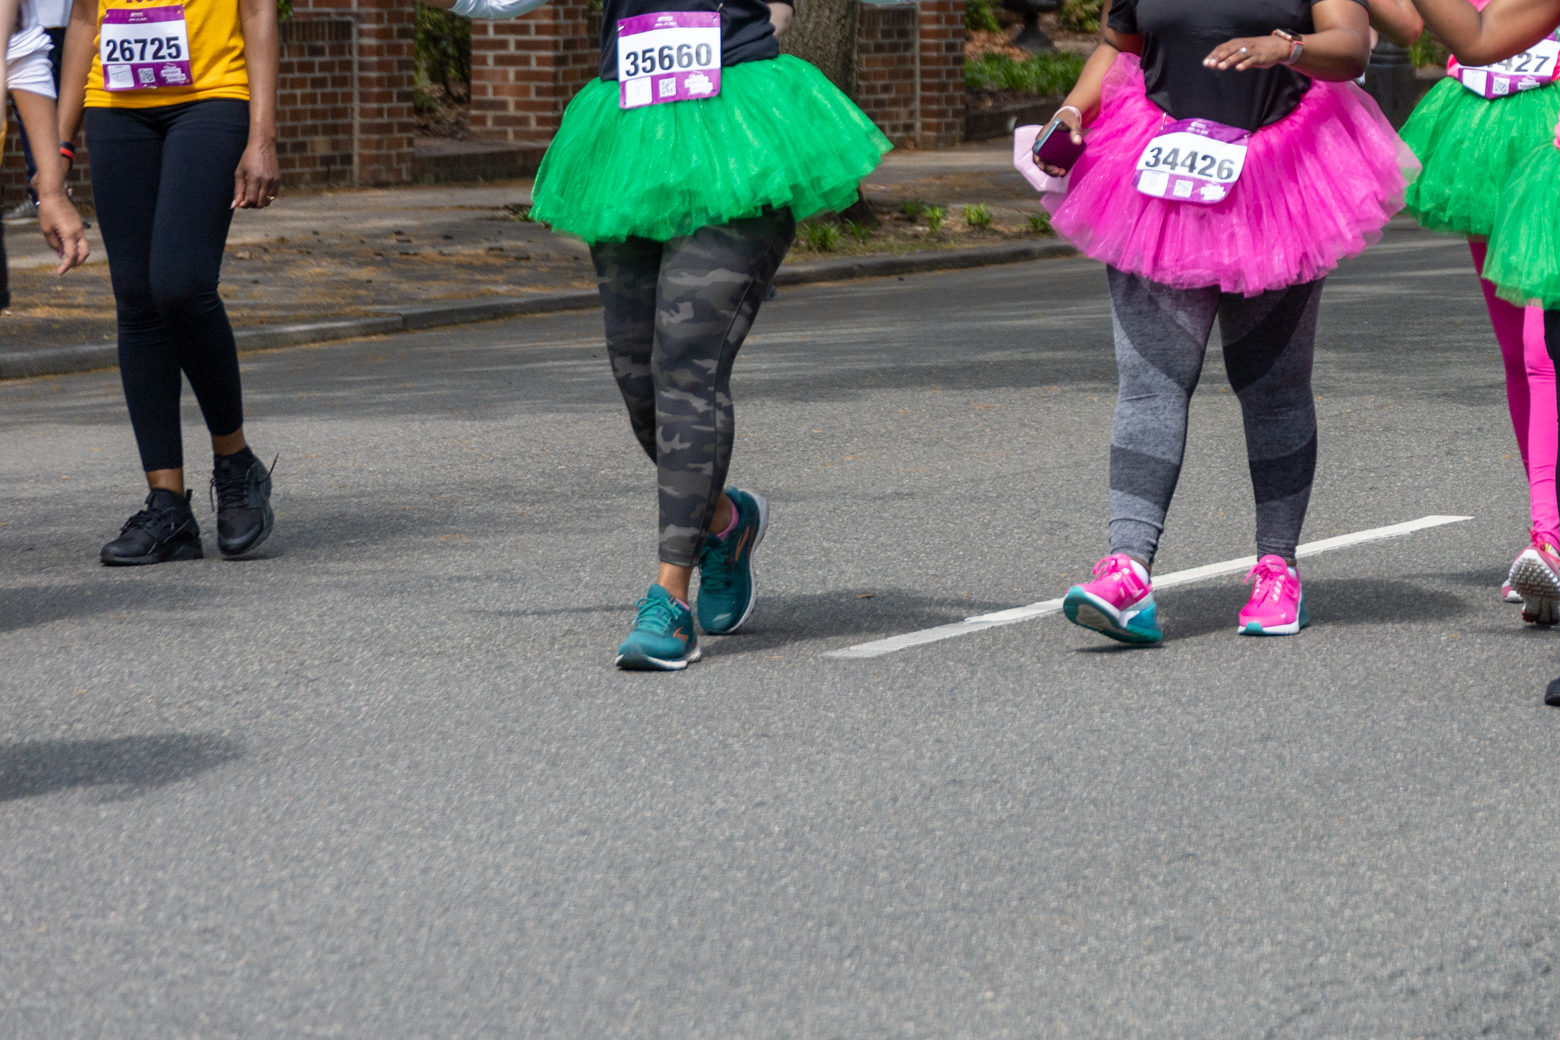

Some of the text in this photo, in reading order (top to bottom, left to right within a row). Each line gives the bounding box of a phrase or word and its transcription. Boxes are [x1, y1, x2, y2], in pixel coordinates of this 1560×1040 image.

[105, 35, 182, 63] 26725
[625, 42, 713, 77] 35660
[1144, 146, 1236, 181] 34426
